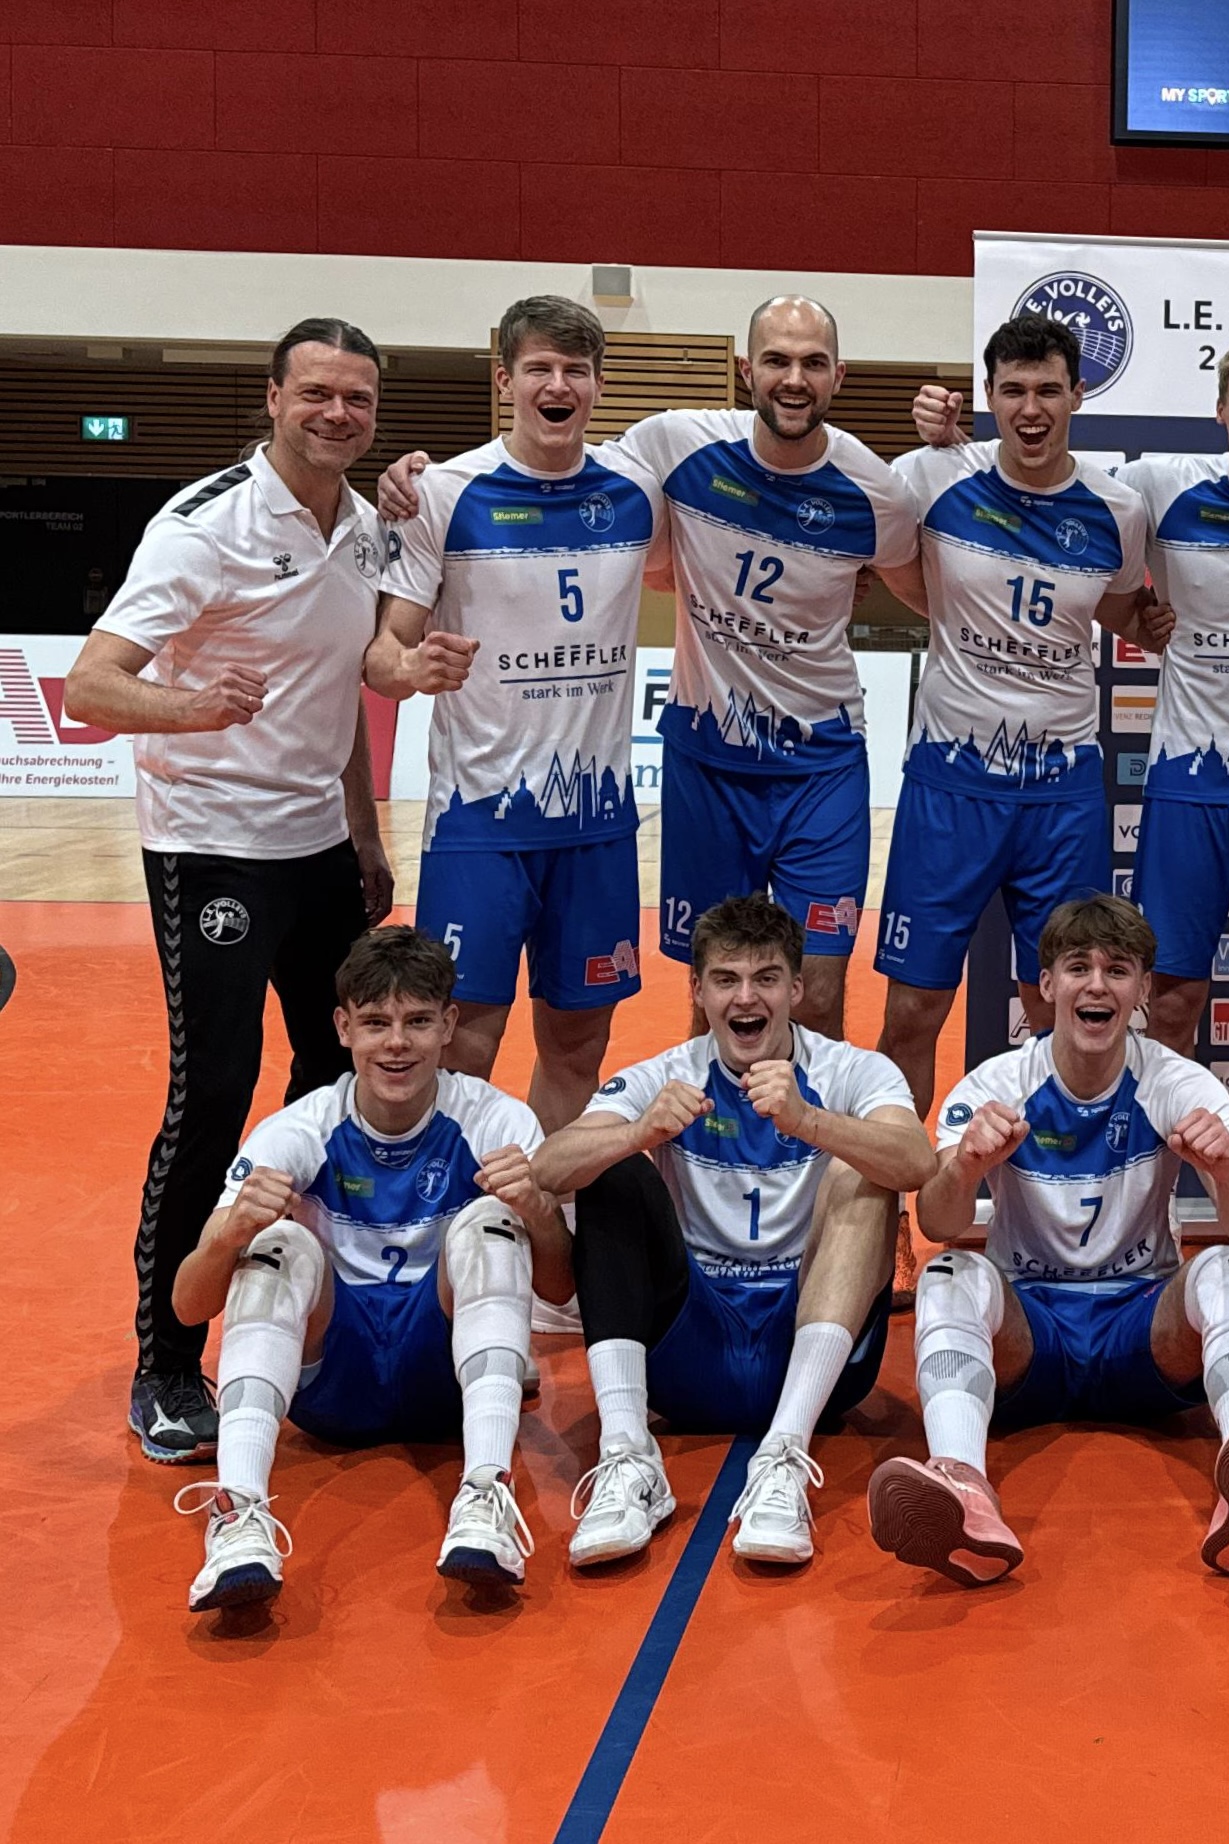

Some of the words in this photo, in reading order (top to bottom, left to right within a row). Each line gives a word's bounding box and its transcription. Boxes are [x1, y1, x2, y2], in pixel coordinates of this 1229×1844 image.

[1161, 87, 1186, 102] MY
[1044, 279, 1124, 333] VOLLEYS
[1163, 299, 1223, 331] L.E.
[558, 568, 584, 623] 5
[734, 550, 785, 604] 12
[690, 593, 810, 645] SHEFFLER
[1006, 575, 1056, 627] 15
[498, 644, 627, 671] SCHEFFLER
[522, 684, 561, 700] stark
[566, 682, 583, 698] im
[25, 773, 119, 787] Energiekosten!
[666, 897, 692, 936] 12
[884, 911, 912, 950] 15
[443, 923, 464, 962] 5
[742, 1187, 761, 1241] 1
[1079, 1196, 1104, 1247] 7
[380, 1245, 412, 1286] 2
